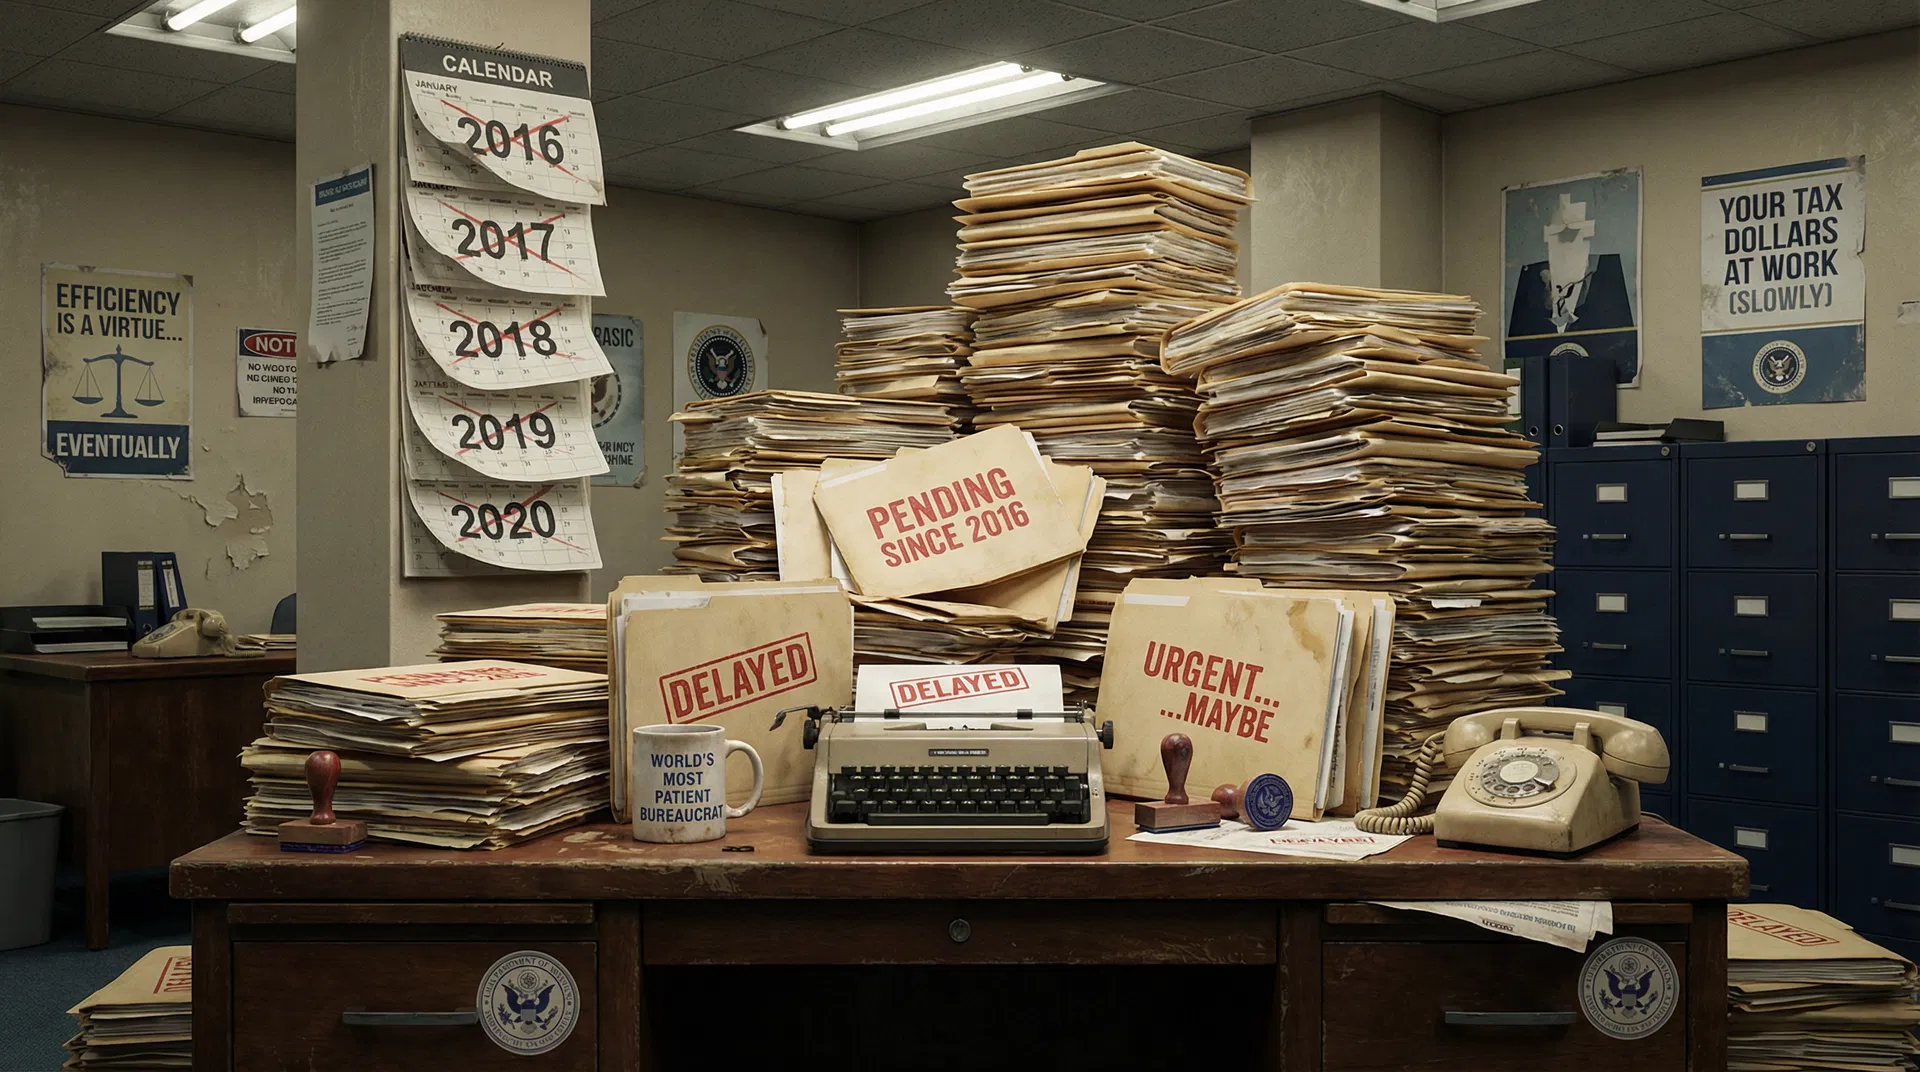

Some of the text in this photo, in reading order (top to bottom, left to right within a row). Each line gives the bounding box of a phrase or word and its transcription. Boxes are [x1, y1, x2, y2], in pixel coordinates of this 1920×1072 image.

[415, 80, 457, 93] JANUARY
[442, 55, 553, 88] CALENDAR
[457, 116, 564, 165] 2016
[1719, 183, 1843, 224] YOUR TAX
[452, 218, 554, 261] 2017
[1724, 216, 1839, 255] DOLLARS
[1724, 249, 1839, 286] AT WORK
[56, 283, 181, 316] EFFICIENCY
[1729, 283, 1833, 315] (SLOWLY)
[57, 312, 183, 341] IS A VIRTUE...
[450, 320, 557, 358] 2018
[248, 363, 261, 371] NO
[273, 386, 285, 394] NO
[56, 432, 181, 459] EVENTUALLY
[452, 411, 555, 451] 2019
[451, 500, 556, 540] 2020
[866, 467, 1016, 540] PENDING
[880, 501, 1030, 568] SINCE 2016
[669, 643, 808, 718] DELAYED
[899, 670, 1021, 703] DELAYED
[1143, 640, 1280, 708] URGENT...
[1160, 691, 1275, 744] ...MAYBE
[650, 752, 715, 768] WORLD'S
[663, 771, 703, 786] MOST
[640, 804, 724, 823] BUREAUCRAT
[655, 788, 711, 805] PATIENT
